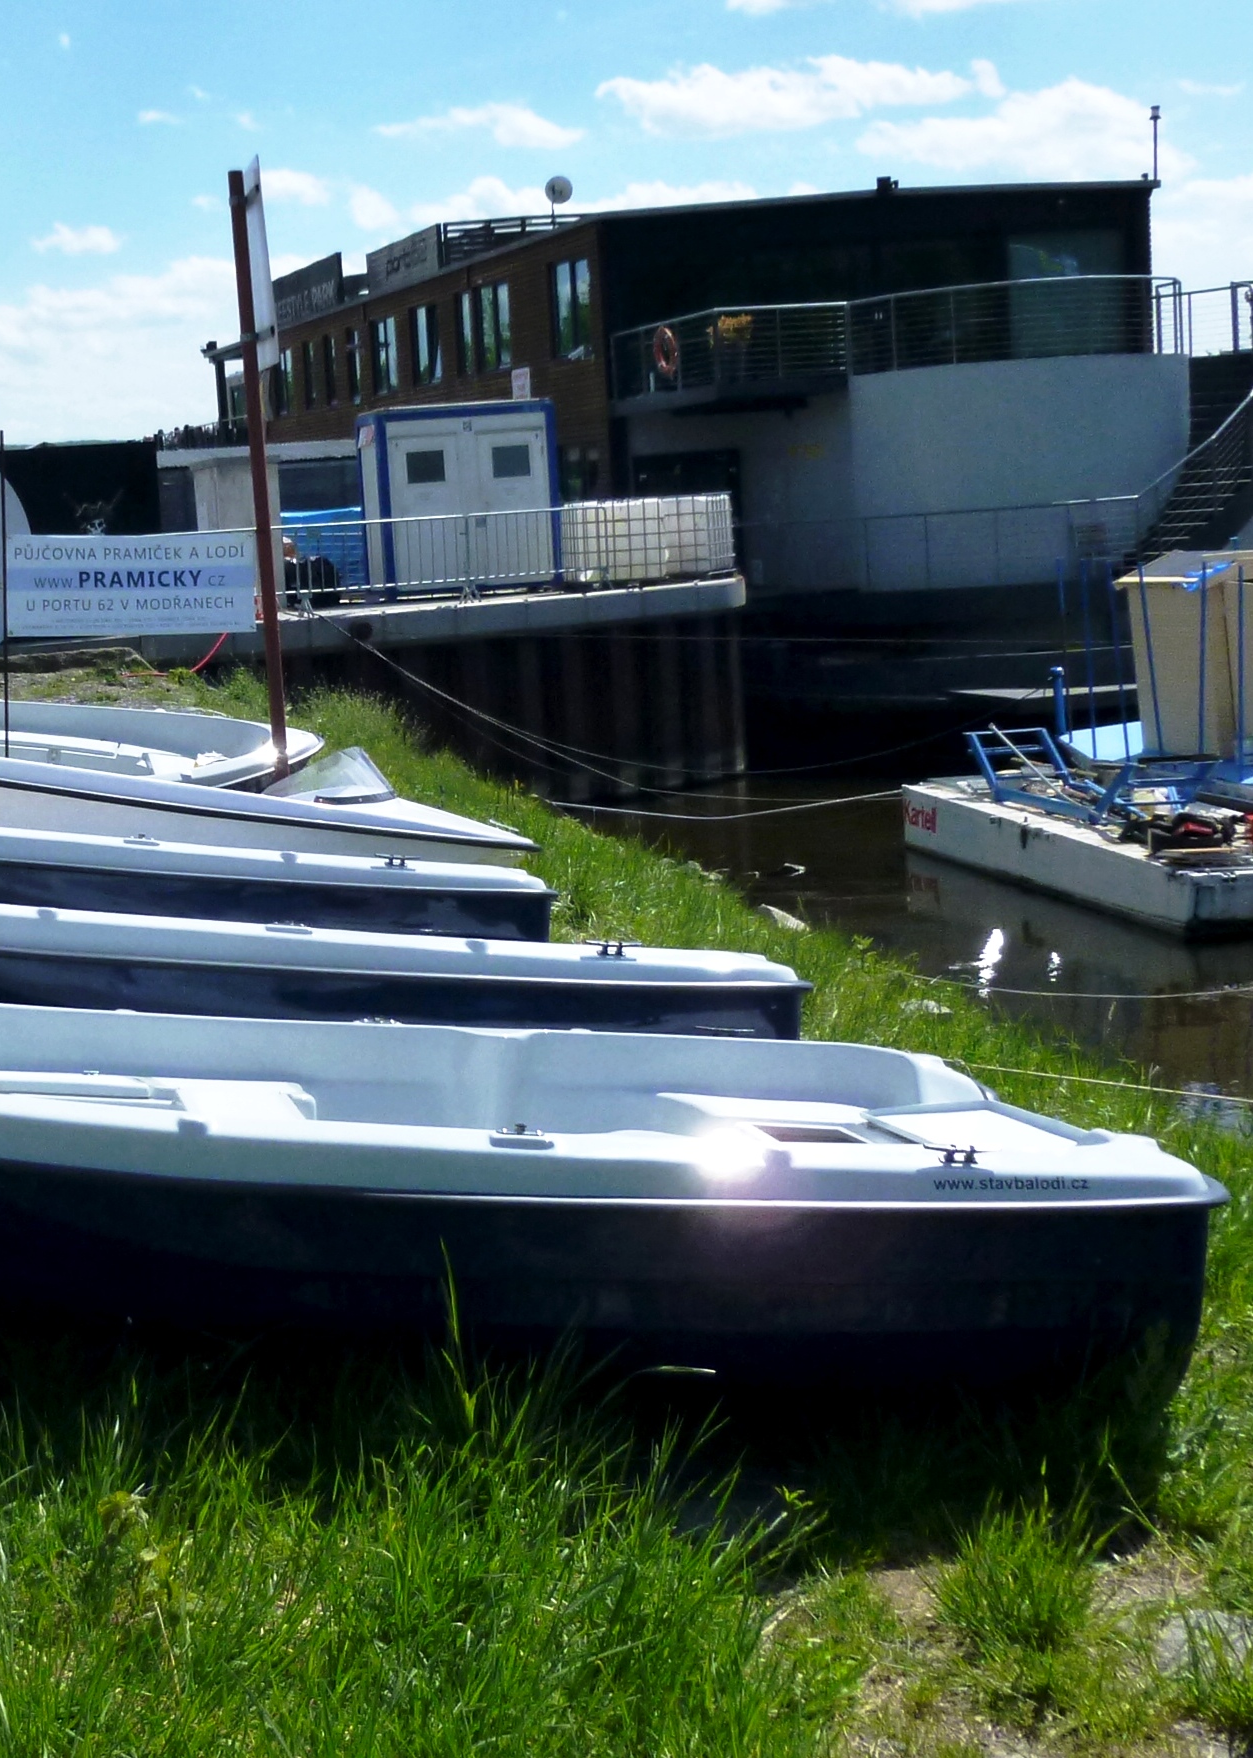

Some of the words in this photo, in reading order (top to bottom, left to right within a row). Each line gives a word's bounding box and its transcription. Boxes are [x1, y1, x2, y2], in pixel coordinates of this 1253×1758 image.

[14, 543, 97, 561] PŮJČOVNA
[103, 544, 182, 561] PRAMIČEK
[189, 546, 199, 559] A
[206, 542, 245, 559] LODÍ
[26, 599, 36, 612] U
[42, 599, 92, 612] PORTU
[97, 599, 114, 612] 62
[120, 599, 129, 611] V
[135, 594, 235, 611] MODŘANECH
[933, 1177, 1089, 1191] www.stavbalodi.cz
